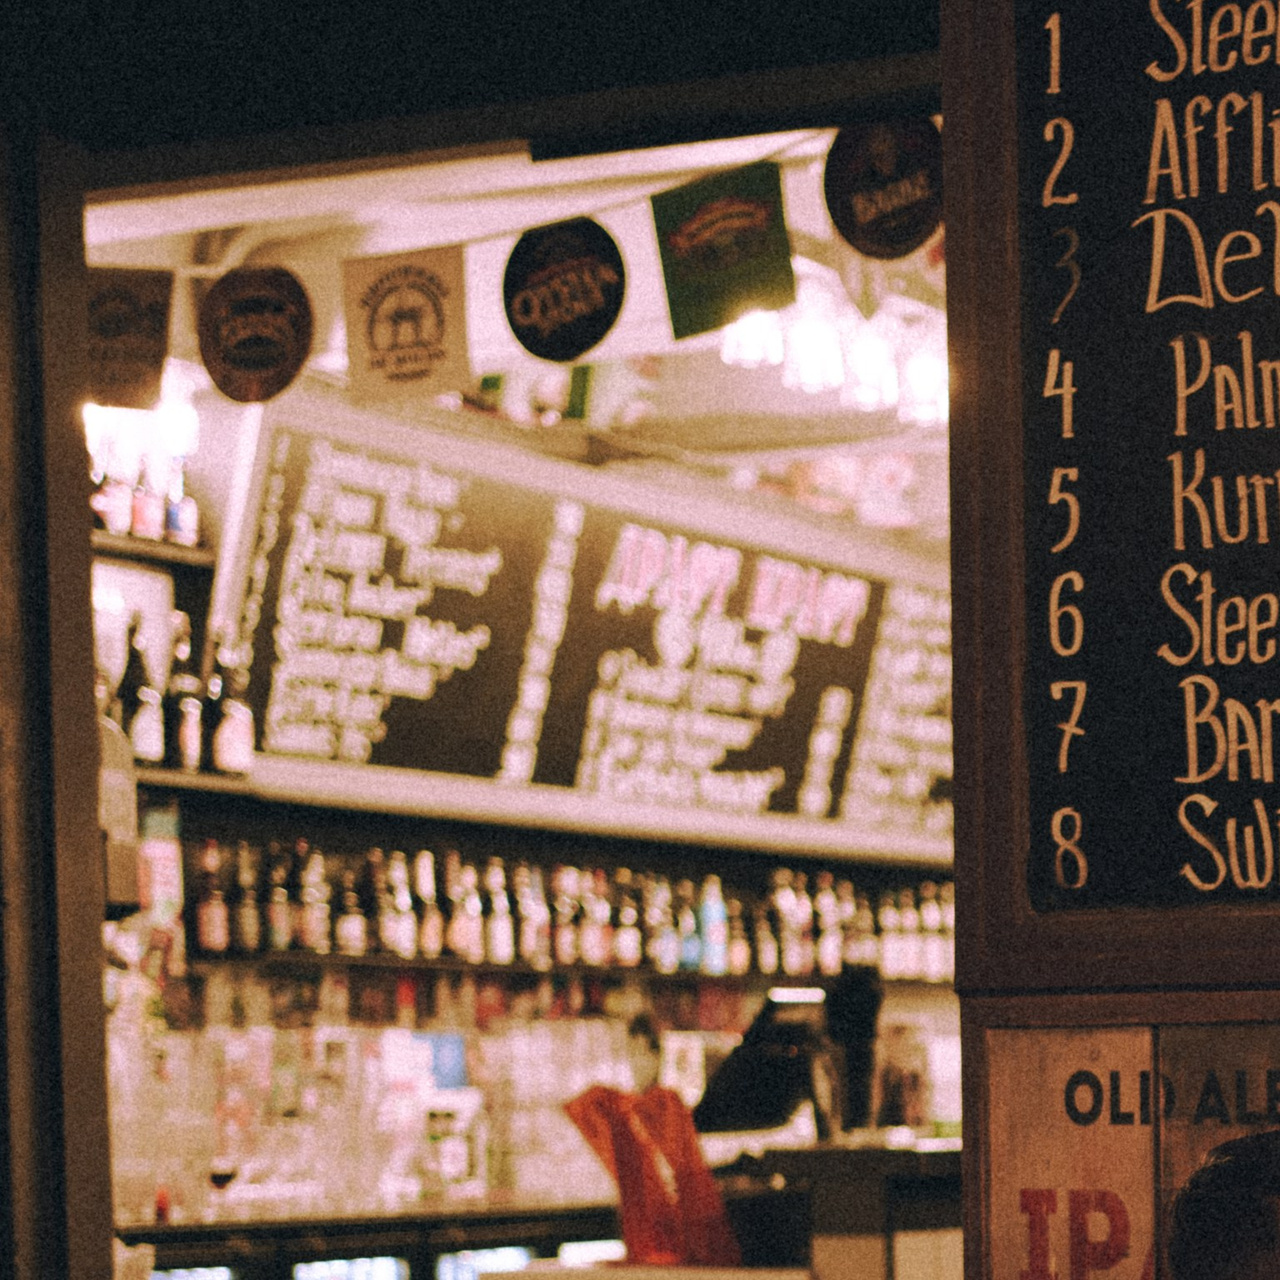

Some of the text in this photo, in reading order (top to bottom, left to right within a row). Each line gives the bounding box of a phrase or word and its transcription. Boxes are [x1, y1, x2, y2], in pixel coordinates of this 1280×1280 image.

[1043, 12, 1062, 96] 1
[1042, 117, 1080, 208] 2
[1042, 348, 1078, 439] 4
[1047, 466, 1082, 554] 5
[1048, 570, 1085, 657] 6
[1049, 680, 1088, 773] 7
[1049, 806, 1090, 889] 8
[1064, 1069, 1176, 1126] OLD
